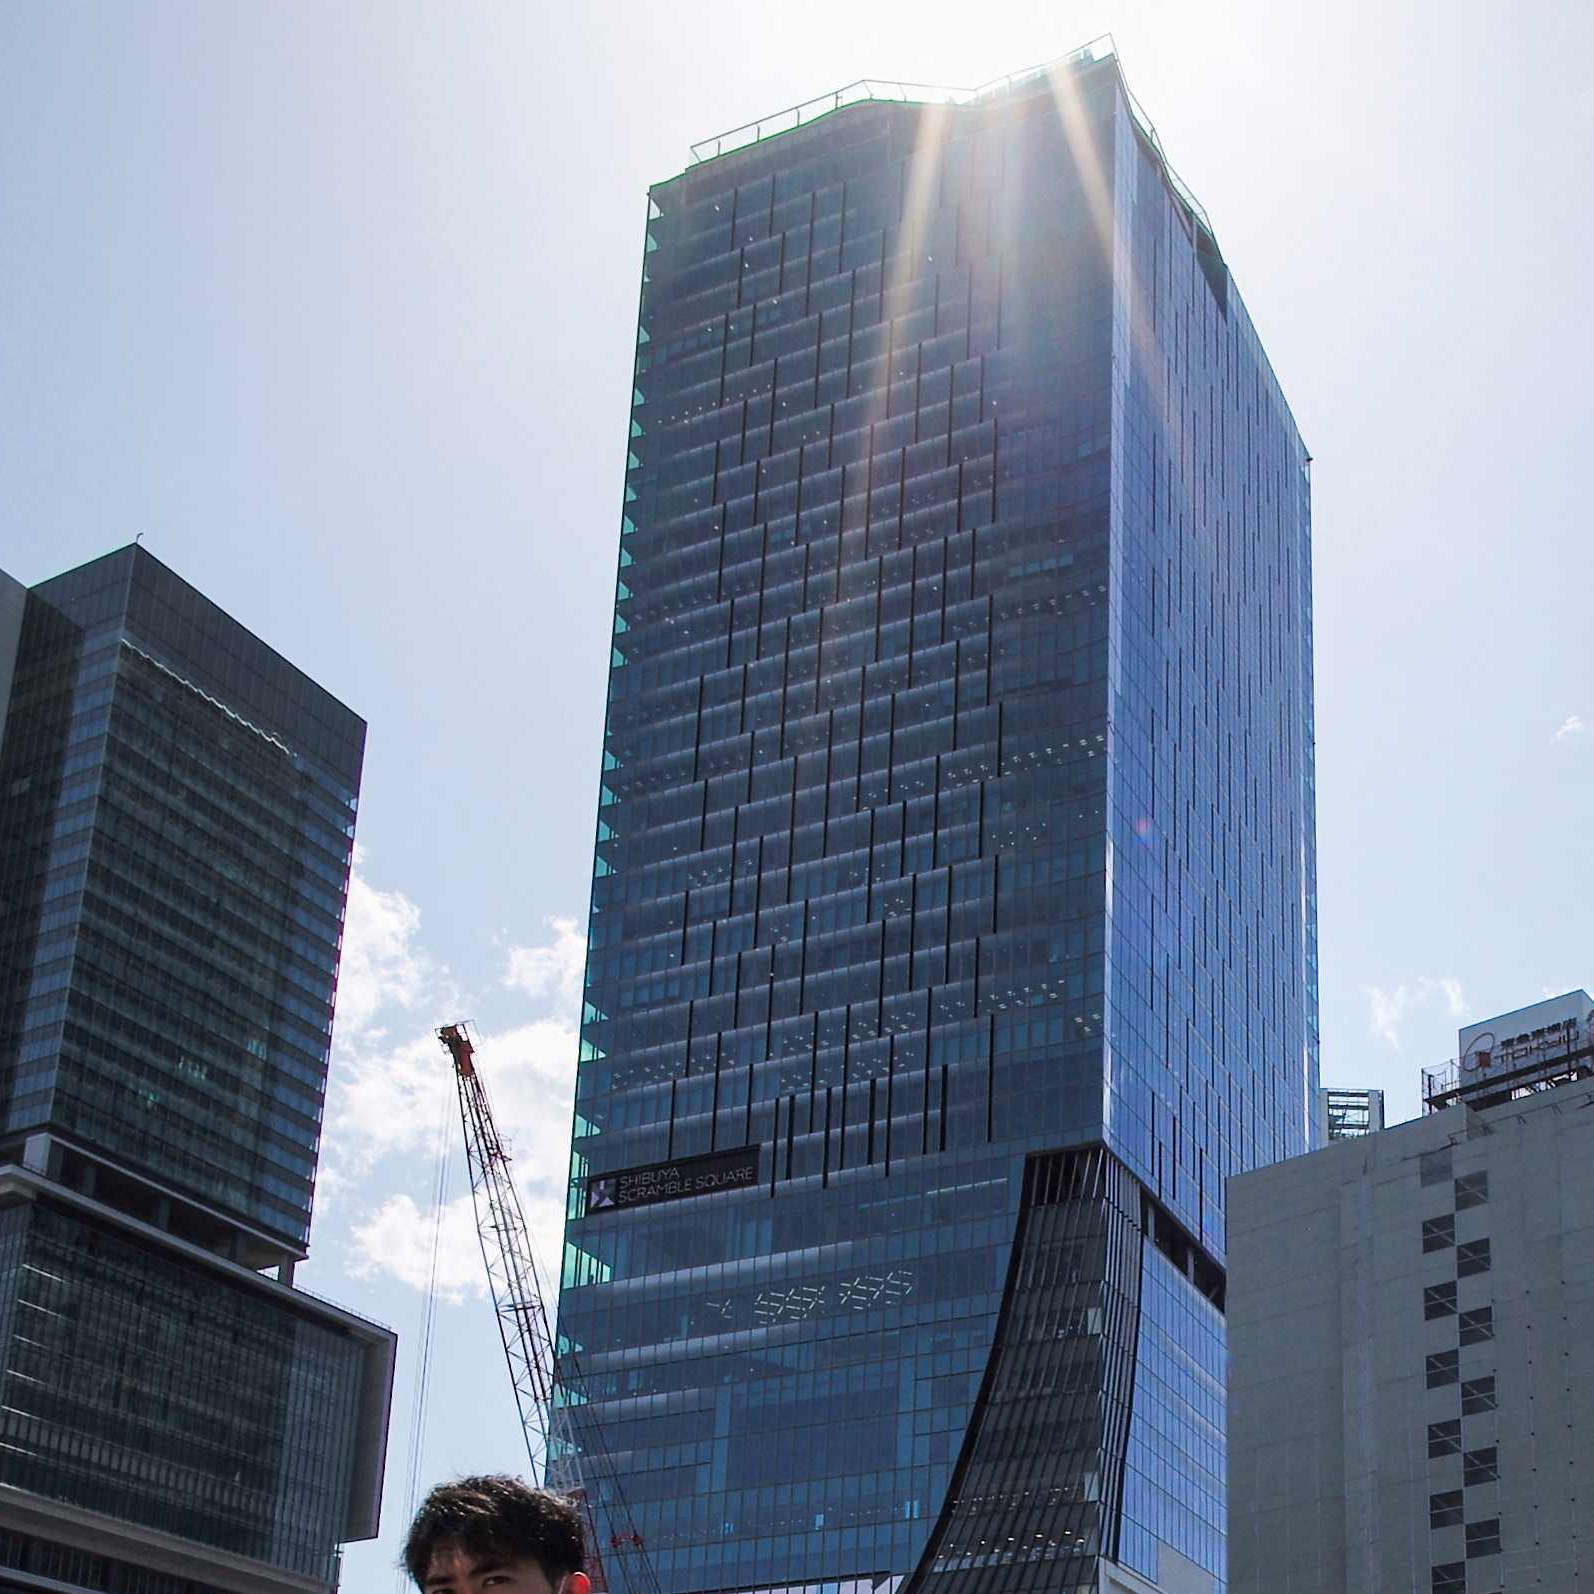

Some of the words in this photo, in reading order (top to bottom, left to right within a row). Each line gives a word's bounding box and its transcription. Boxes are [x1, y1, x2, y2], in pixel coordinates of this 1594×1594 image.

[618, 1181, 692, 1203] SCRAMBLE
[694, 1166, 754, 1189] SQUARE
[619, 1167, 680, 1189] SHIBUYA
